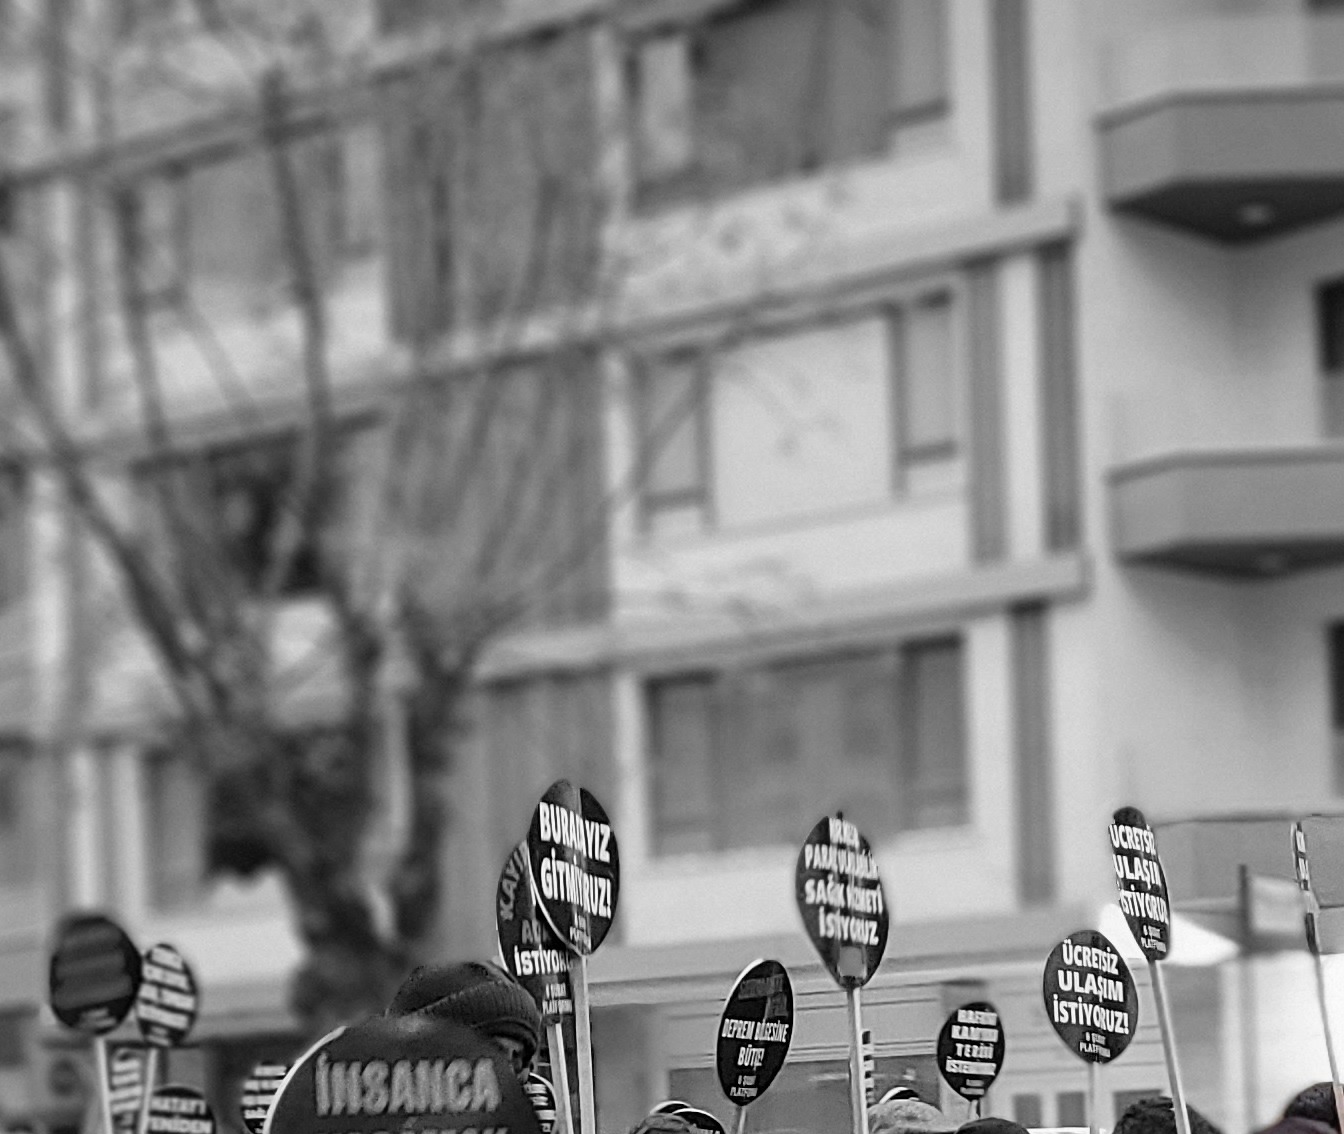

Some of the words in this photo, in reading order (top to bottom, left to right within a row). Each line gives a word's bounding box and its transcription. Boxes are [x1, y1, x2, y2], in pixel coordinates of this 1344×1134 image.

[540, 847, 612, 920] GİTMİYRUZ!
[1062, 938, 1119, 975] ÜCRETSİZ
[1057, 969, 1124, 1003] ULAŞIM
[1053, 993, 1130, 1035] İSTİYORUZ!
[315, 1052, 502, 1117] İNSANCA
